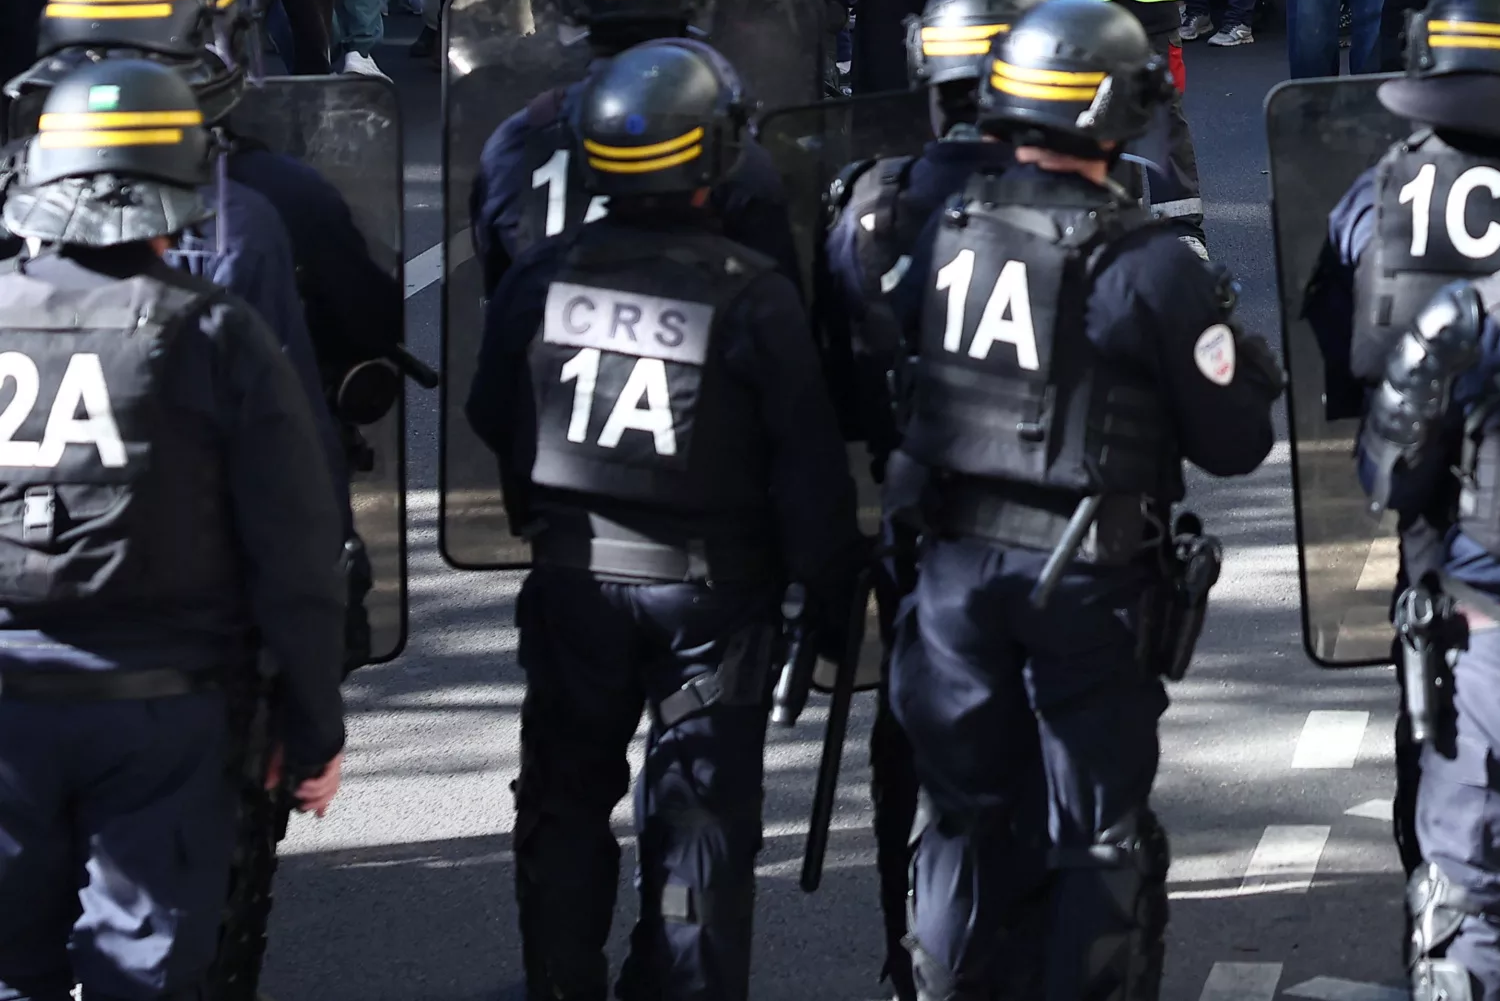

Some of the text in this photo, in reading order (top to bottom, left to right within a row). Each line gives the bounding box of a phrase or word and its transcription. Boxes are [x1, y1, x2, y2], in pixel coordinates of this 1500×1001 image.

[562, 295, 688, 347] CRS
[935, 248, 1040, 371] 1A
[0, 351, 128, 468] 2A
[560, 347, 677, 456] 1A
